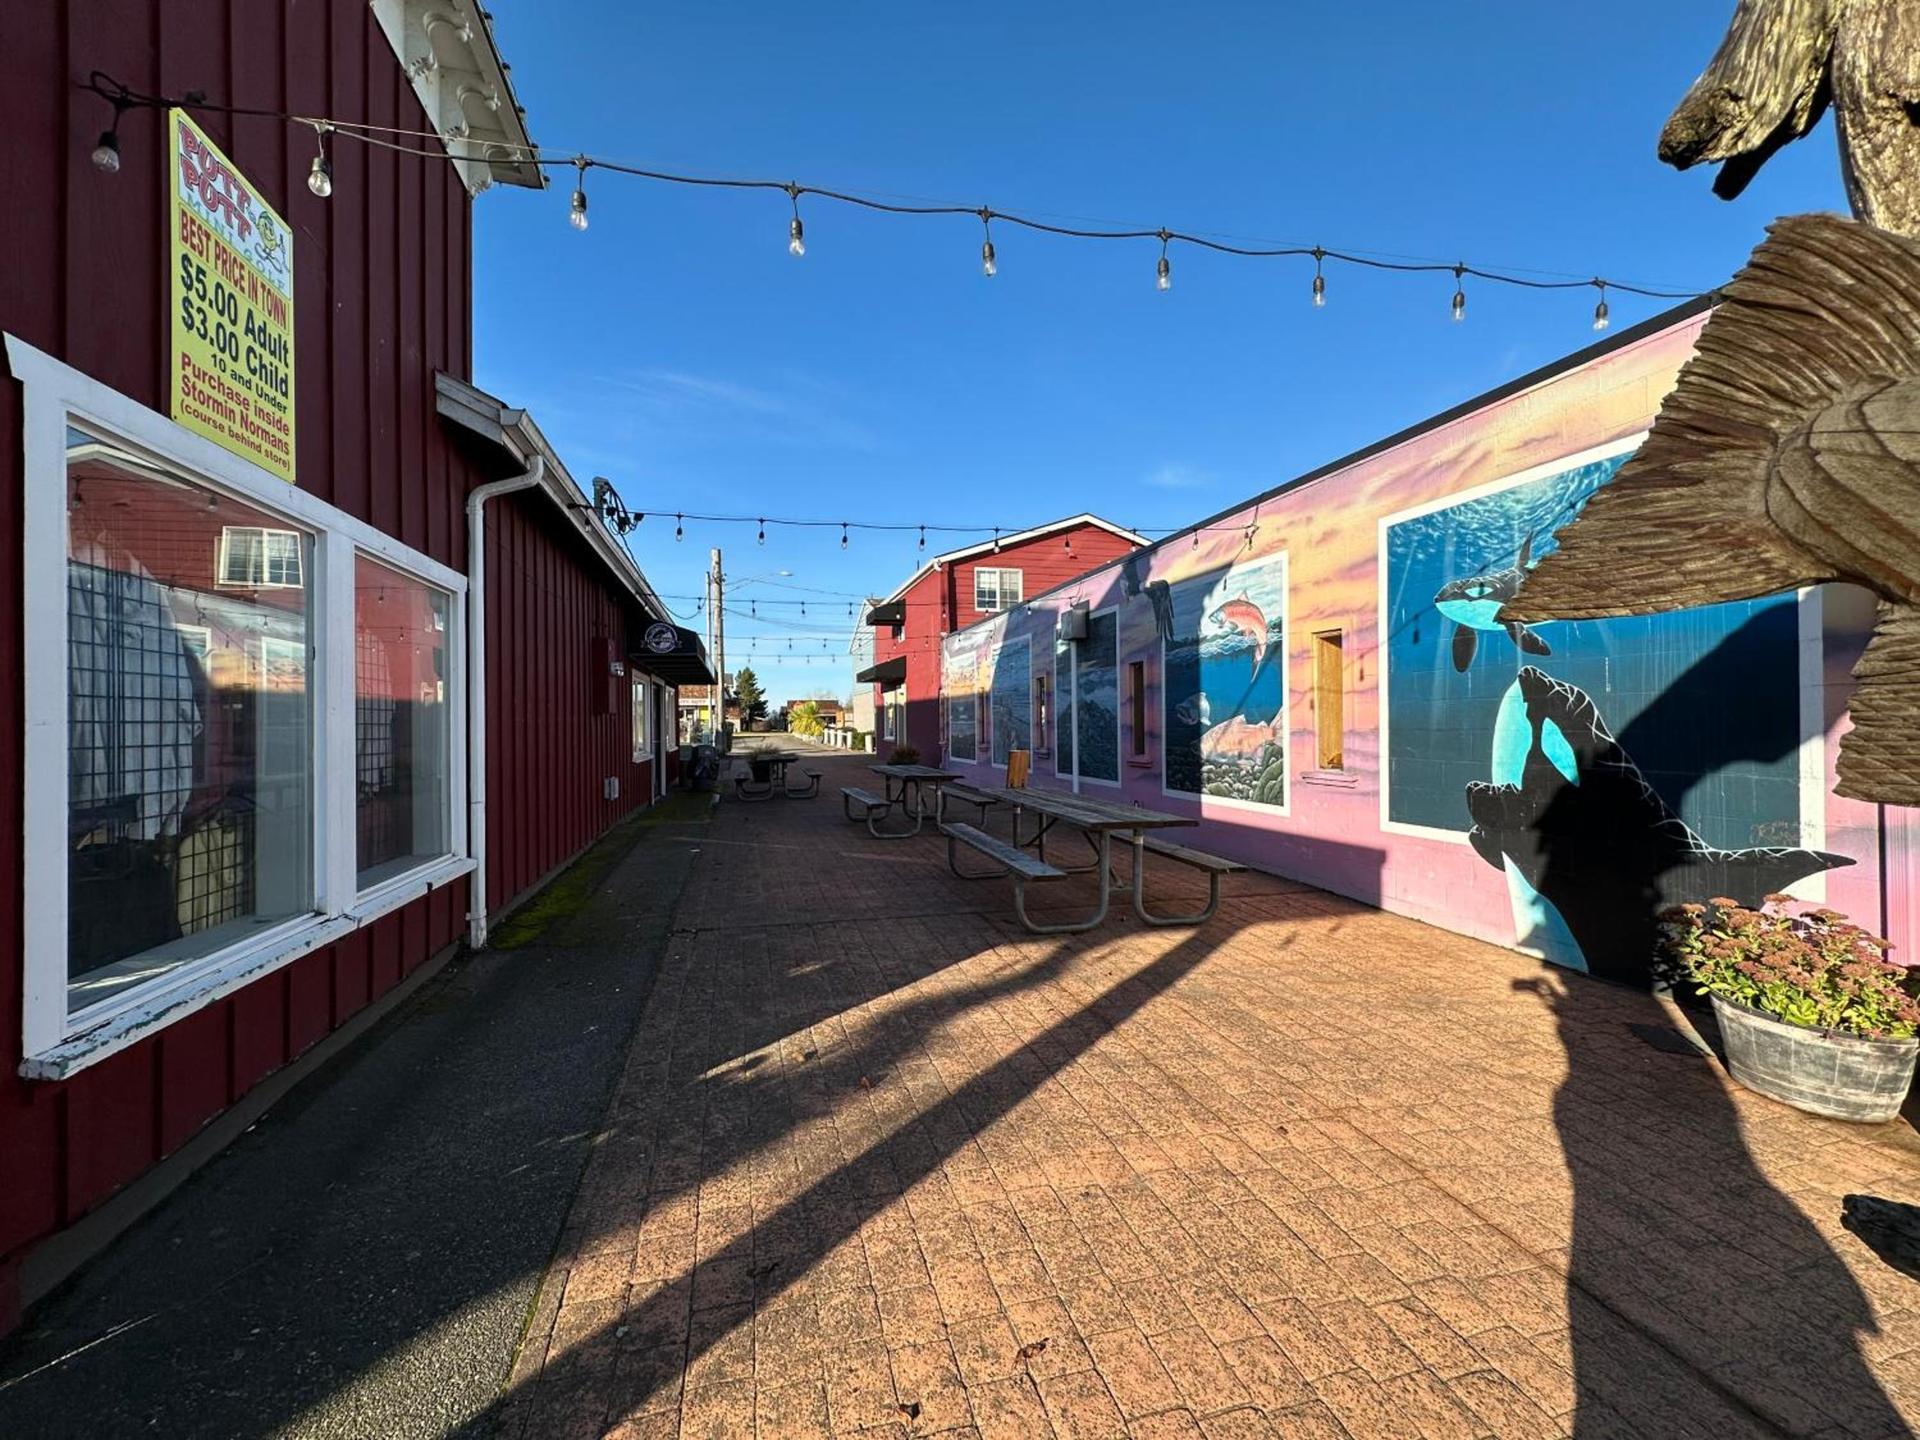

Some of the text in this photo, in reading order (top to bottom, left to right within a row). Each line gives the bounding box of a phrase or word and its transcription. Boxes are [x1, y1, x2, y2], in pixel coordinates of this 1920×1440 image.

[180, 120, 251, 214] PUTT
[180, 153, 251, 241] PUTT
[181, 207, 286, 330] BEST PRICE IN TOWN
[181, 253, 289, 369] $5.00 Adult
[181, 295, 288, 400] $3.00 Child
[210, 353, 287, 414] 10 and Under
[180, 398, 290, 472] (course behind store)
[181, 351, 290, 437] Purchase inside
[181, 373, 290, 456] Stormin Normans
